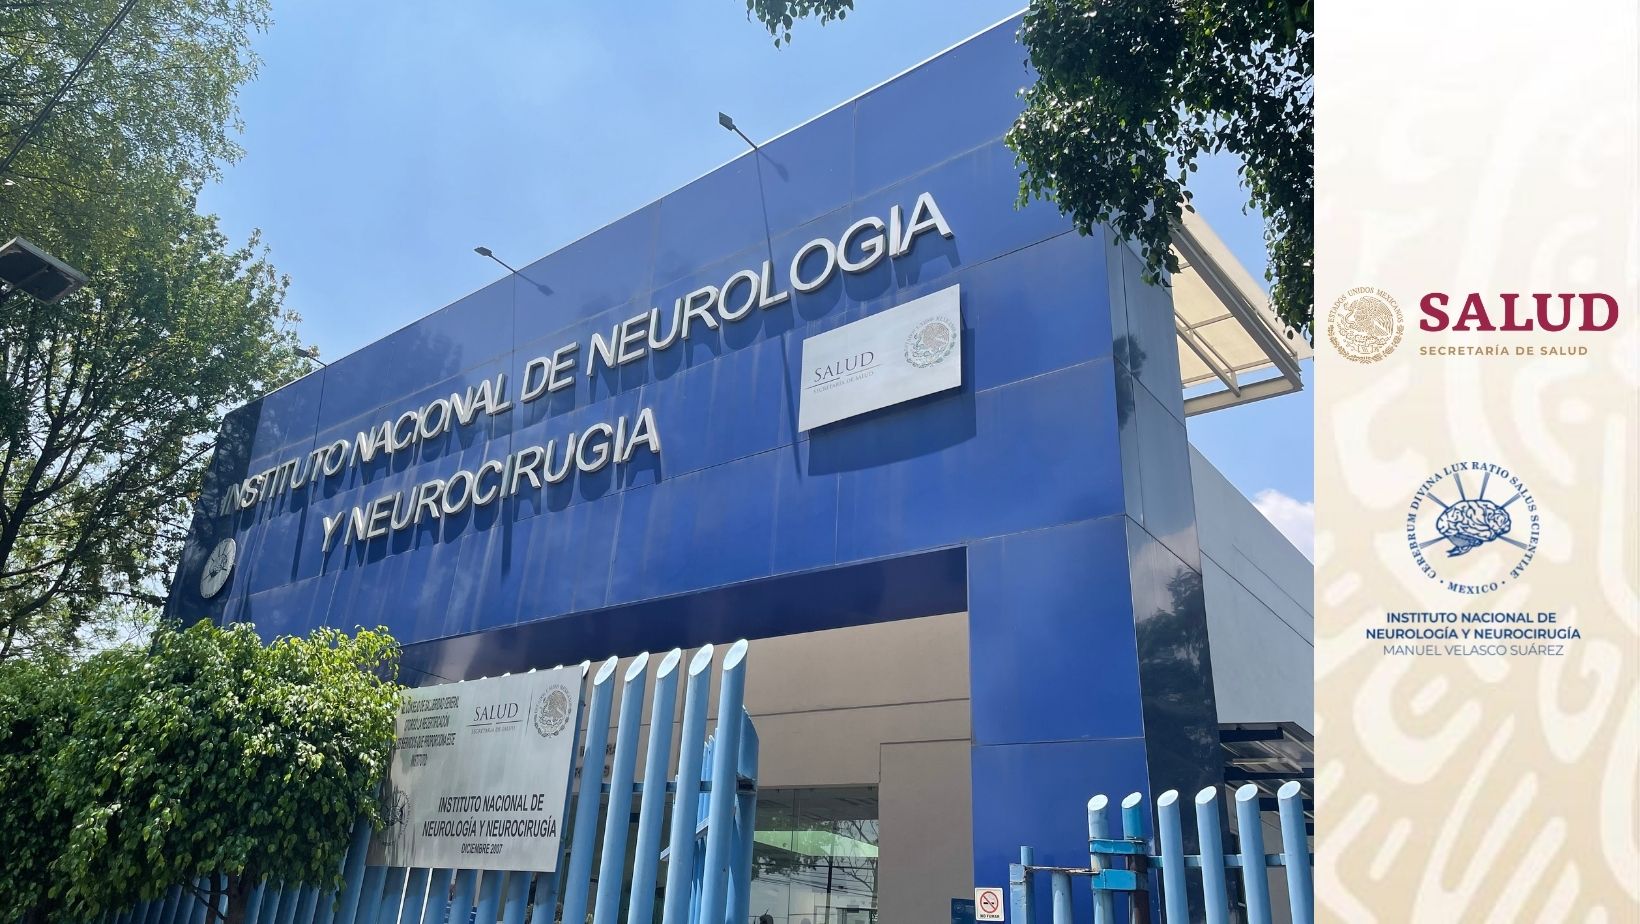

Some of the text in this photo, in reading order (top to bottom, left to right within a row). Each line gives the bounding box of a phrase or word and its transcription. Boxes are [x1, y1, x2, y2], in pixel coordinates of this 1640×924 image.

[221, 191, 953, 515] INSTITUTO NACIONAL DE NEUROLOGIA
[814, 351, 874, 382] SALUD
[321, 407, 660, 552] Y NEUROCIRUGIA
[474, 703, 519, 721] SALUD
[438, 793, 545, 813] INSTITUTO NACIONAL DE
[422, 815, 557, 838] NEUROLOGÍA Y NEUROCIRUGÍA
[460, 843, 490, 854] DICIEMBRE
